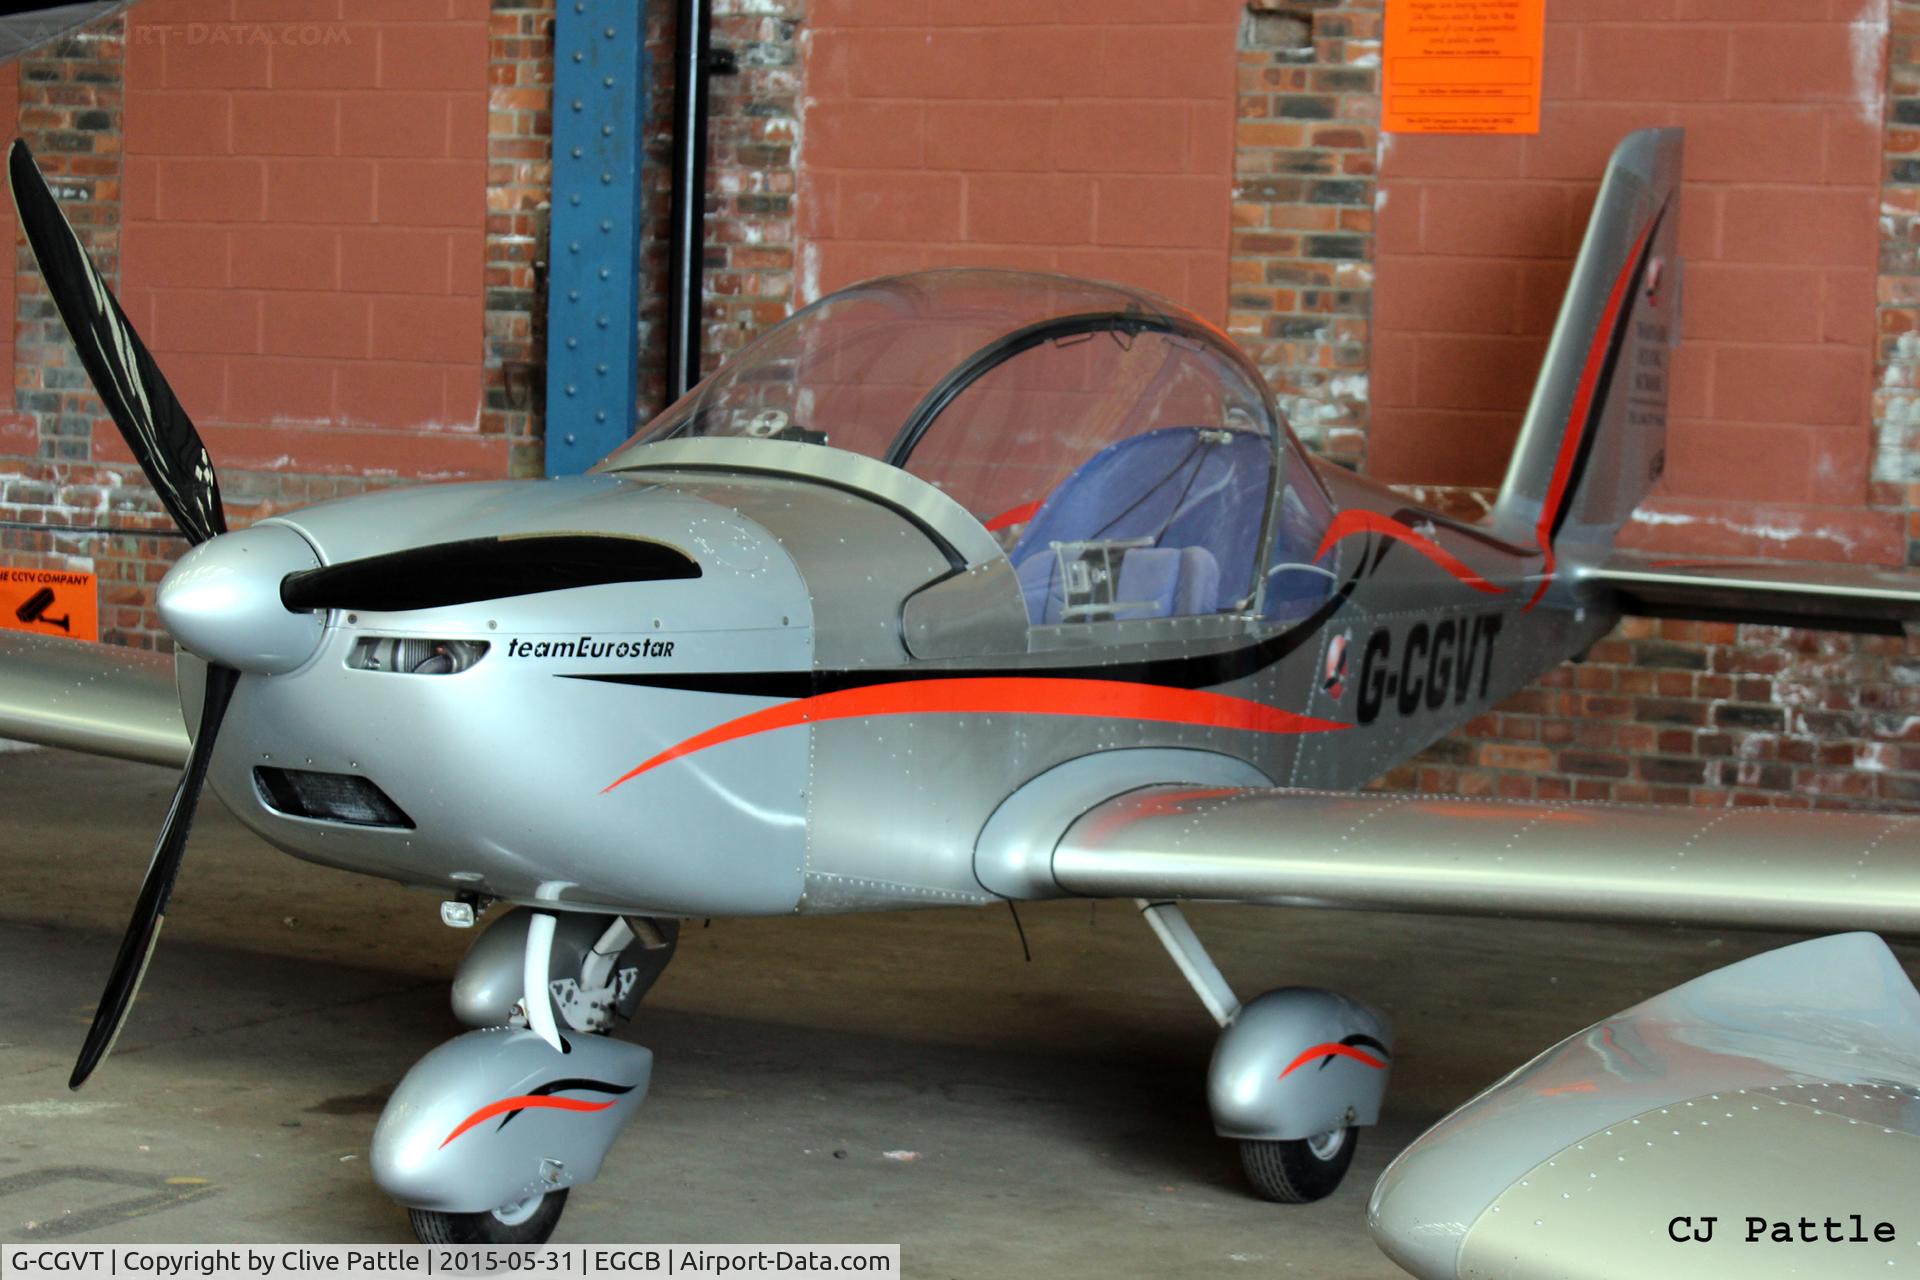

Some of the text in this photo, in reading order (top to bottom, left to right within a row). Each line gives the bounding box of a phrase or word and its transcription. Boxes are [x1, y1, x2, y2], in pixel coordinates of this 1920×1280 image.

[11, 571, 36, 583] CCTV
[37, 573, 89, 585] COMPANY
[1356, 612, 1503, 727] G-CGVT
